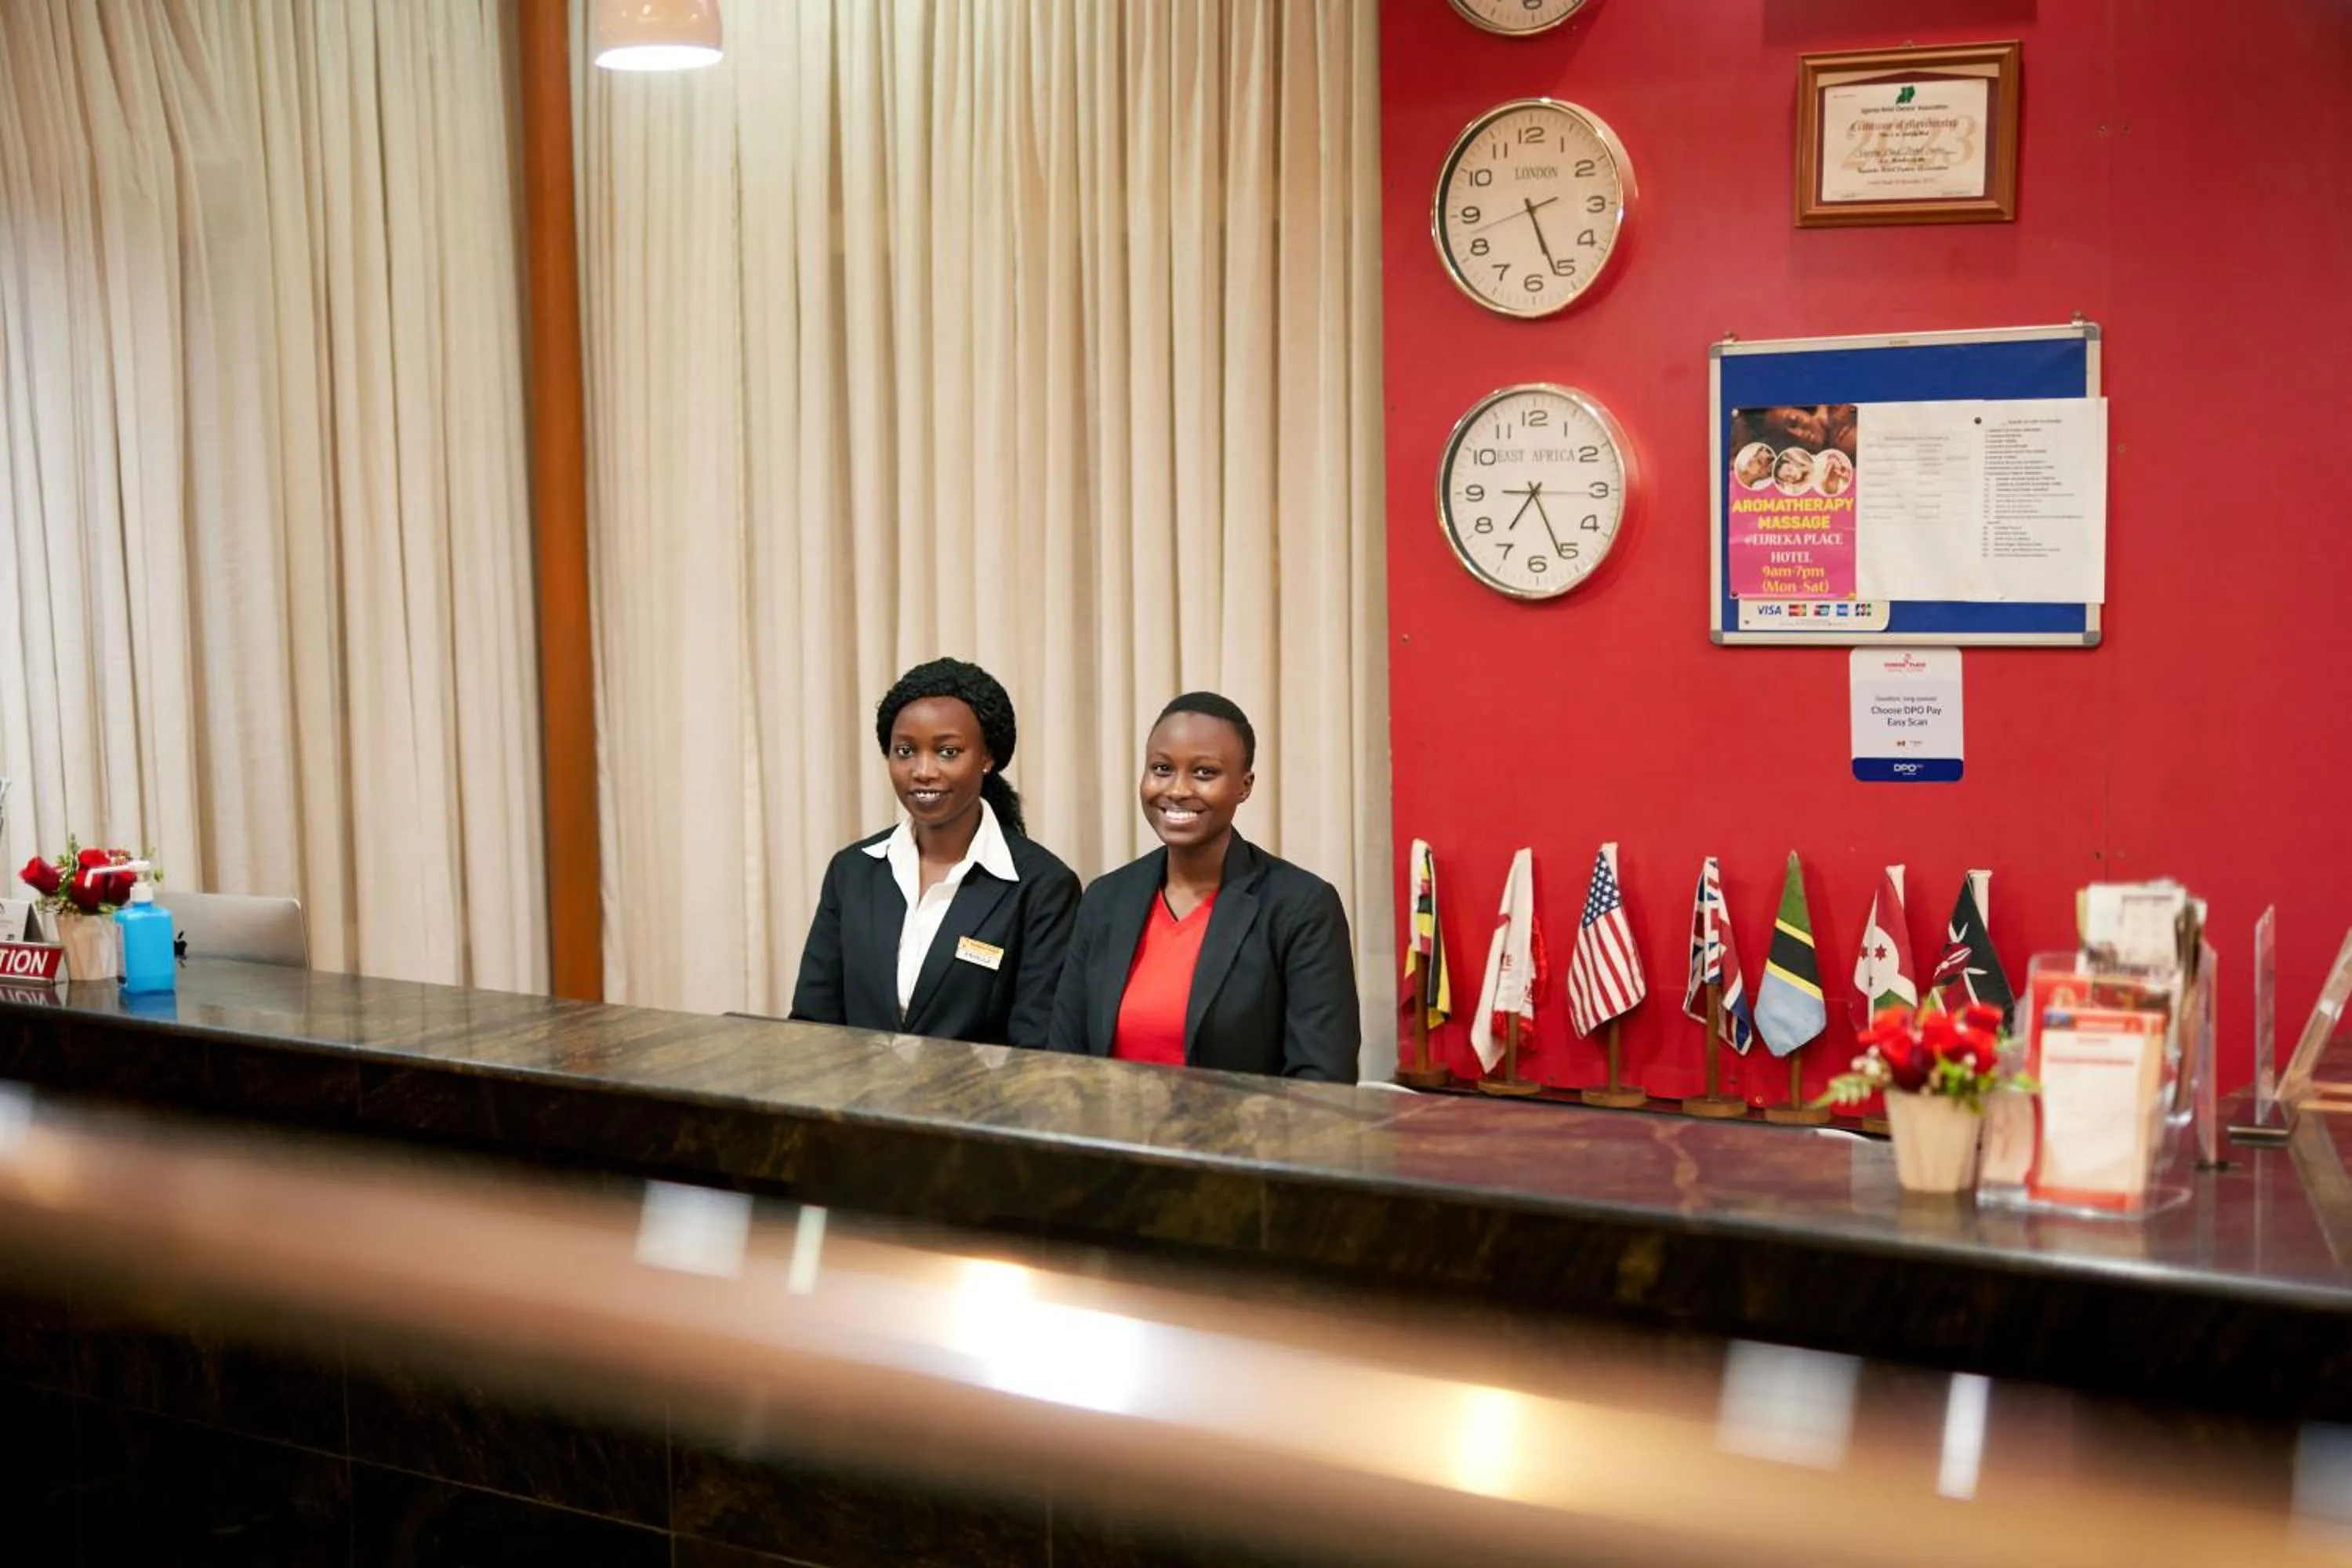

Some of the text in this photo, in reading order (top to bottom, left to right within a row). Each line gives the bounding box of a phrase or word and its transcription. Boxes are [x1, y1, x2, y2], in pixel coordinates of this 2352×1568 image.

[1518, 126, 1545, 145] 12
[1492, 142, 1508, 160] 11
[1559, 136, 1565, 154] 1
[1468, 169, 1493, 187] 10
[1514, 165, 1559, 180] LONDON
[1574, 160, 1595, 179] 2
[1587, 195, 1606, 214] 3
[1461, 205, 1481, 224] 9
[1470, 238, 1490, 256] 8
[1577, 229, 1597, 248] 4
[1493, 264, 1511, 281] 7
[1555, 260, 1576, 278] 5
[1524, 274, 1544, 292] 6
[1522, 410, 1548, 427] 12
[1496, 424, 1512, 440] 11
[1563, 422, 1568, 437] 1
[1473, 448, 1497, 466] 10
[1497, 449, 1576, 463] EAST AFRICA
[1578, 446, 1599, 463] 2
[1465, 485, 1484, 502] 9
[1589, 481, 1609, 499] 3
[1733, 496, 1854, 513] AROMATHERAPY
[1475, 517, 1494, 533] 8
[1581, 514, 1600, 532] 4
[1758, 515, 1831, 530] MASSAGE
[1803, 532, 1843, 545] PLACE
[1495, 543, 1514, 560] 7
[1559, 543, 1578, 559] 5
[1770, 550, 1811, 564] HOTEL
[1528, 557, 1547, 572] 6
[1757, 604, 1783, 616] VISA
[1871, 705, 1942, 716] Choose DPO Pay
[1887, 717, 1928, 728] Easy Scan
[1893, 764, 1917, 772] DPO
